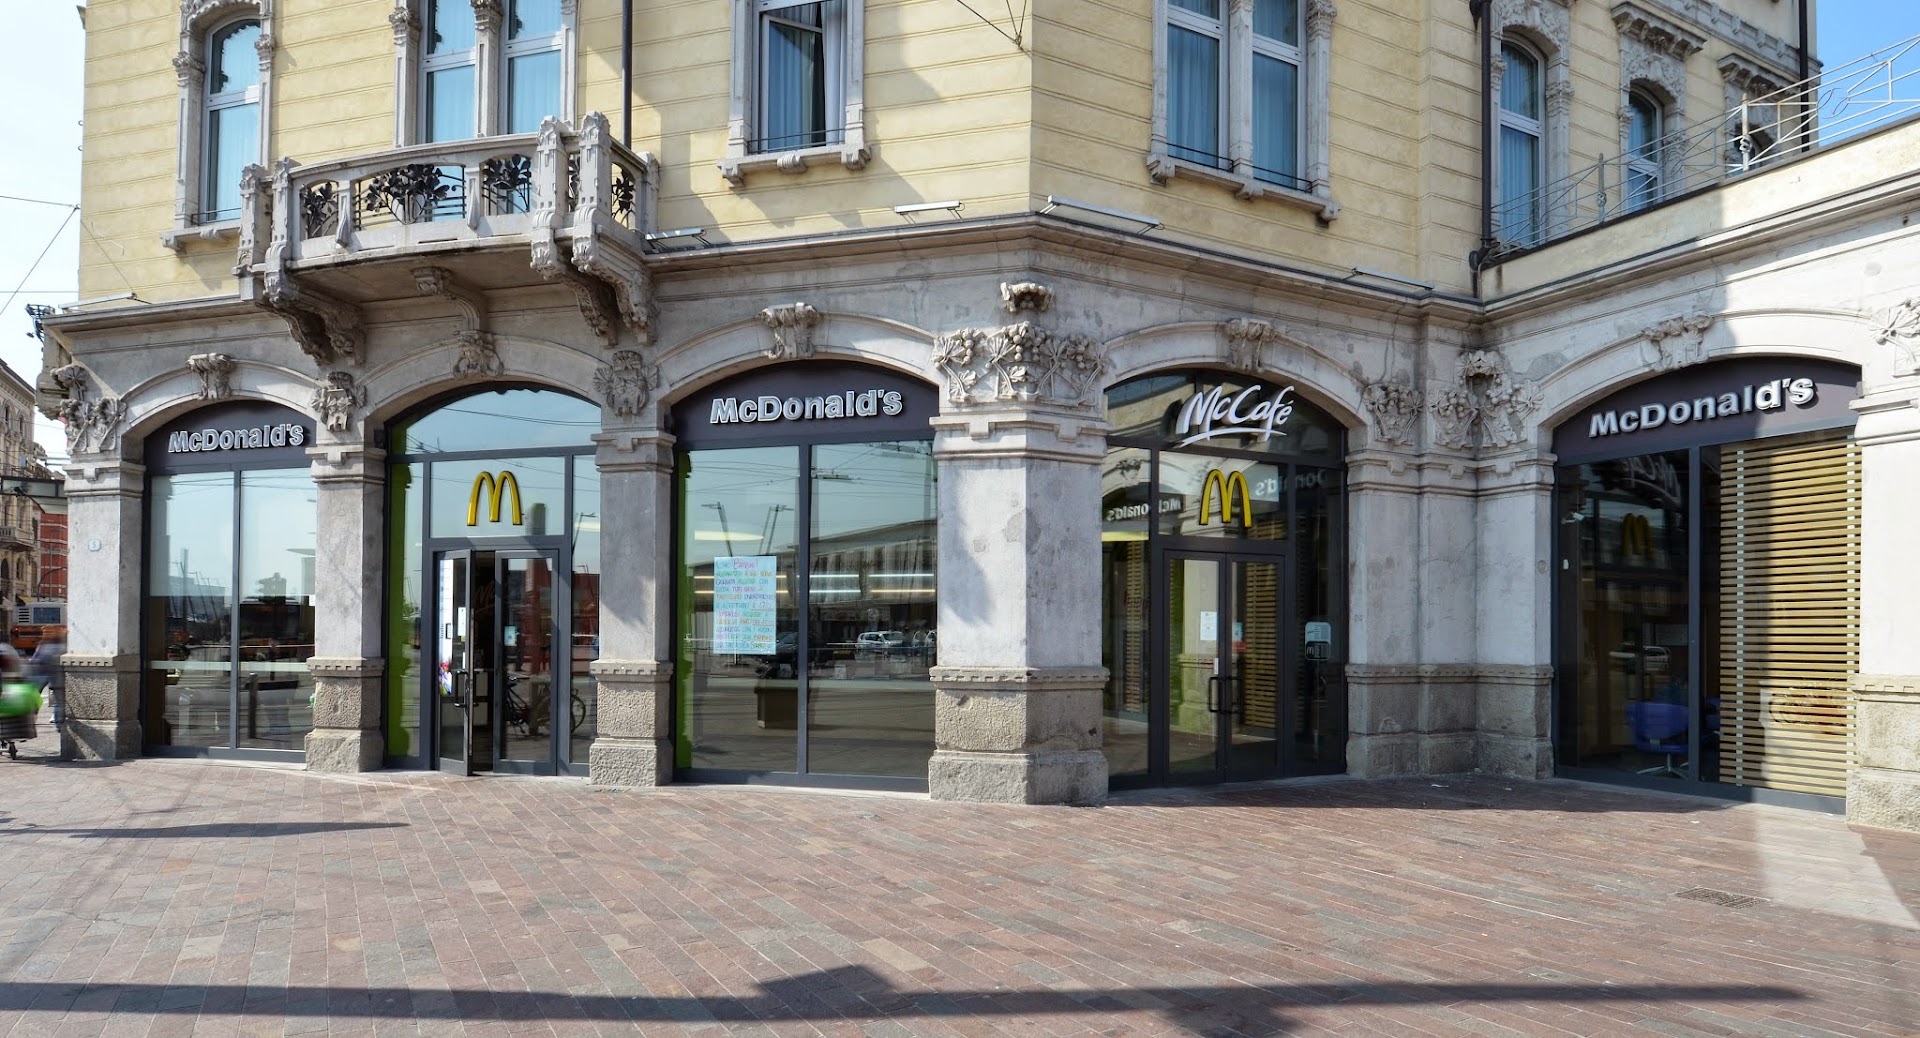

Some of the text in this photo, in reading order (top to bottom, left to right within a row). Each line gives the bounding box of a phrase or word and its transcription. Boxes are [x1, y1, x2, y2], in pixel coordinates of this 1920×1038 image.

[709, 388, 904, 425] McDonald's
[1176, 384, 1295, 442] McCafé
[1588, 377, 1816, 438] McDonald's
[168, 423, 305, 454] McDonald's
